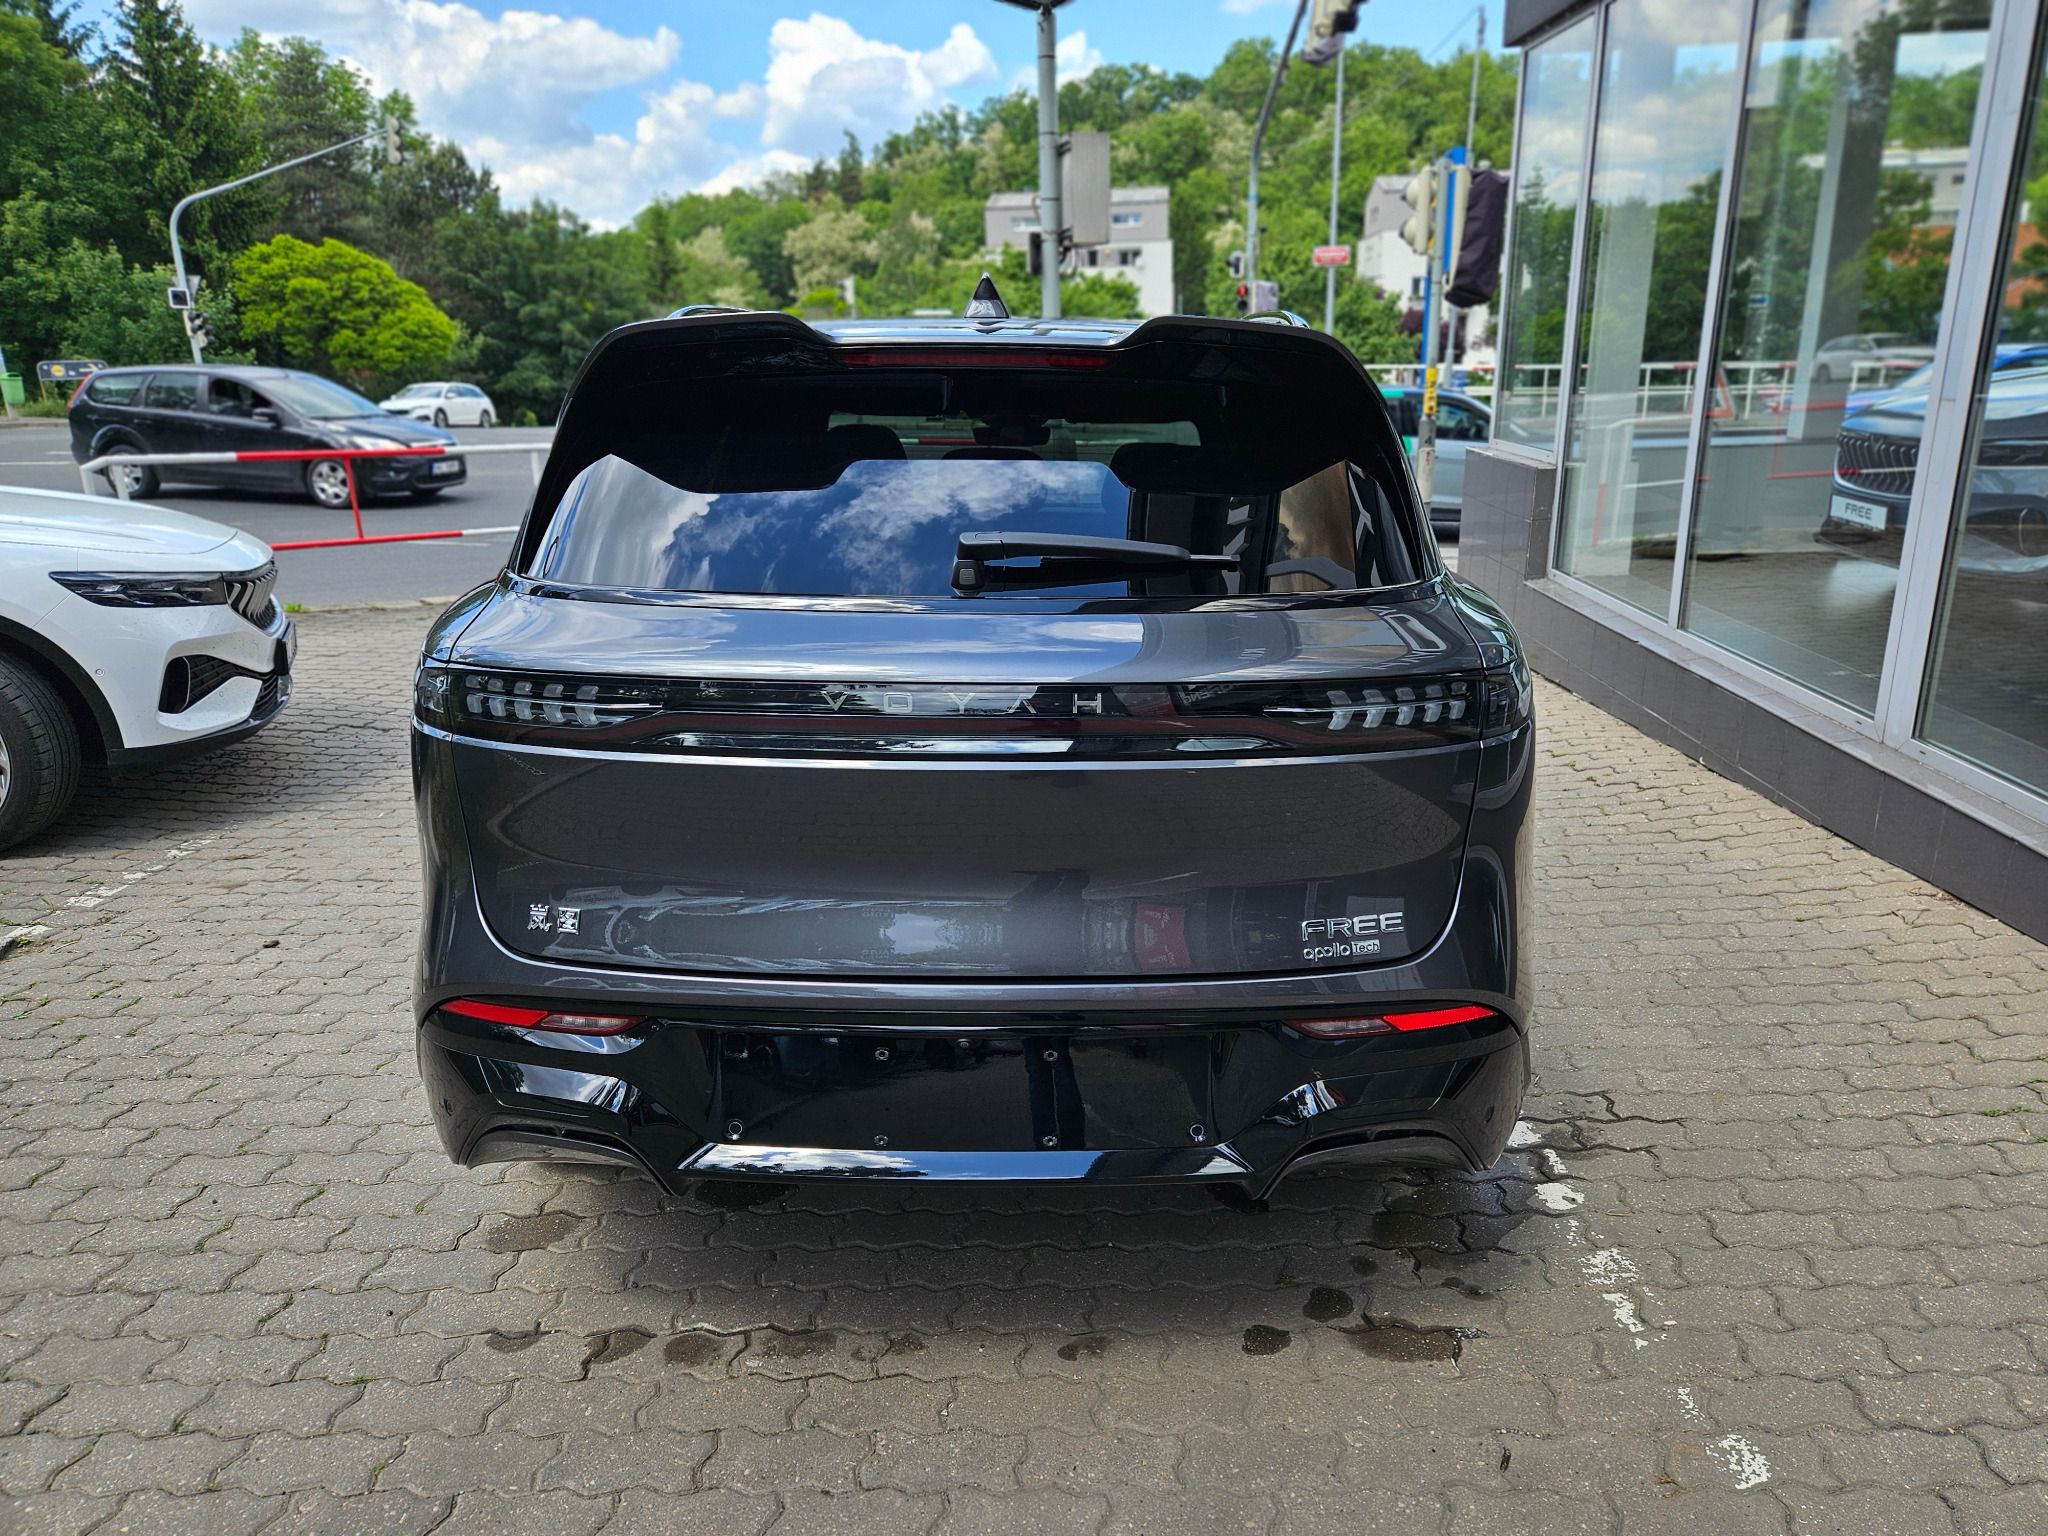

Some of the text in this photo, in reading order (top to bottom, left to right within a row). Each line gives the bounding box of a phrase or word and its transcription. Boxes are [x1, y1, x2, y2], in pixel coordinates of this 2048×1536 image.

[1844, 502, 1873, 521] FREE
[821, 690, 1103, 714] VOYAH
[1301, 911, 1405, 941] FREE
[1303, 941, 1380, 962] apollo Tech
